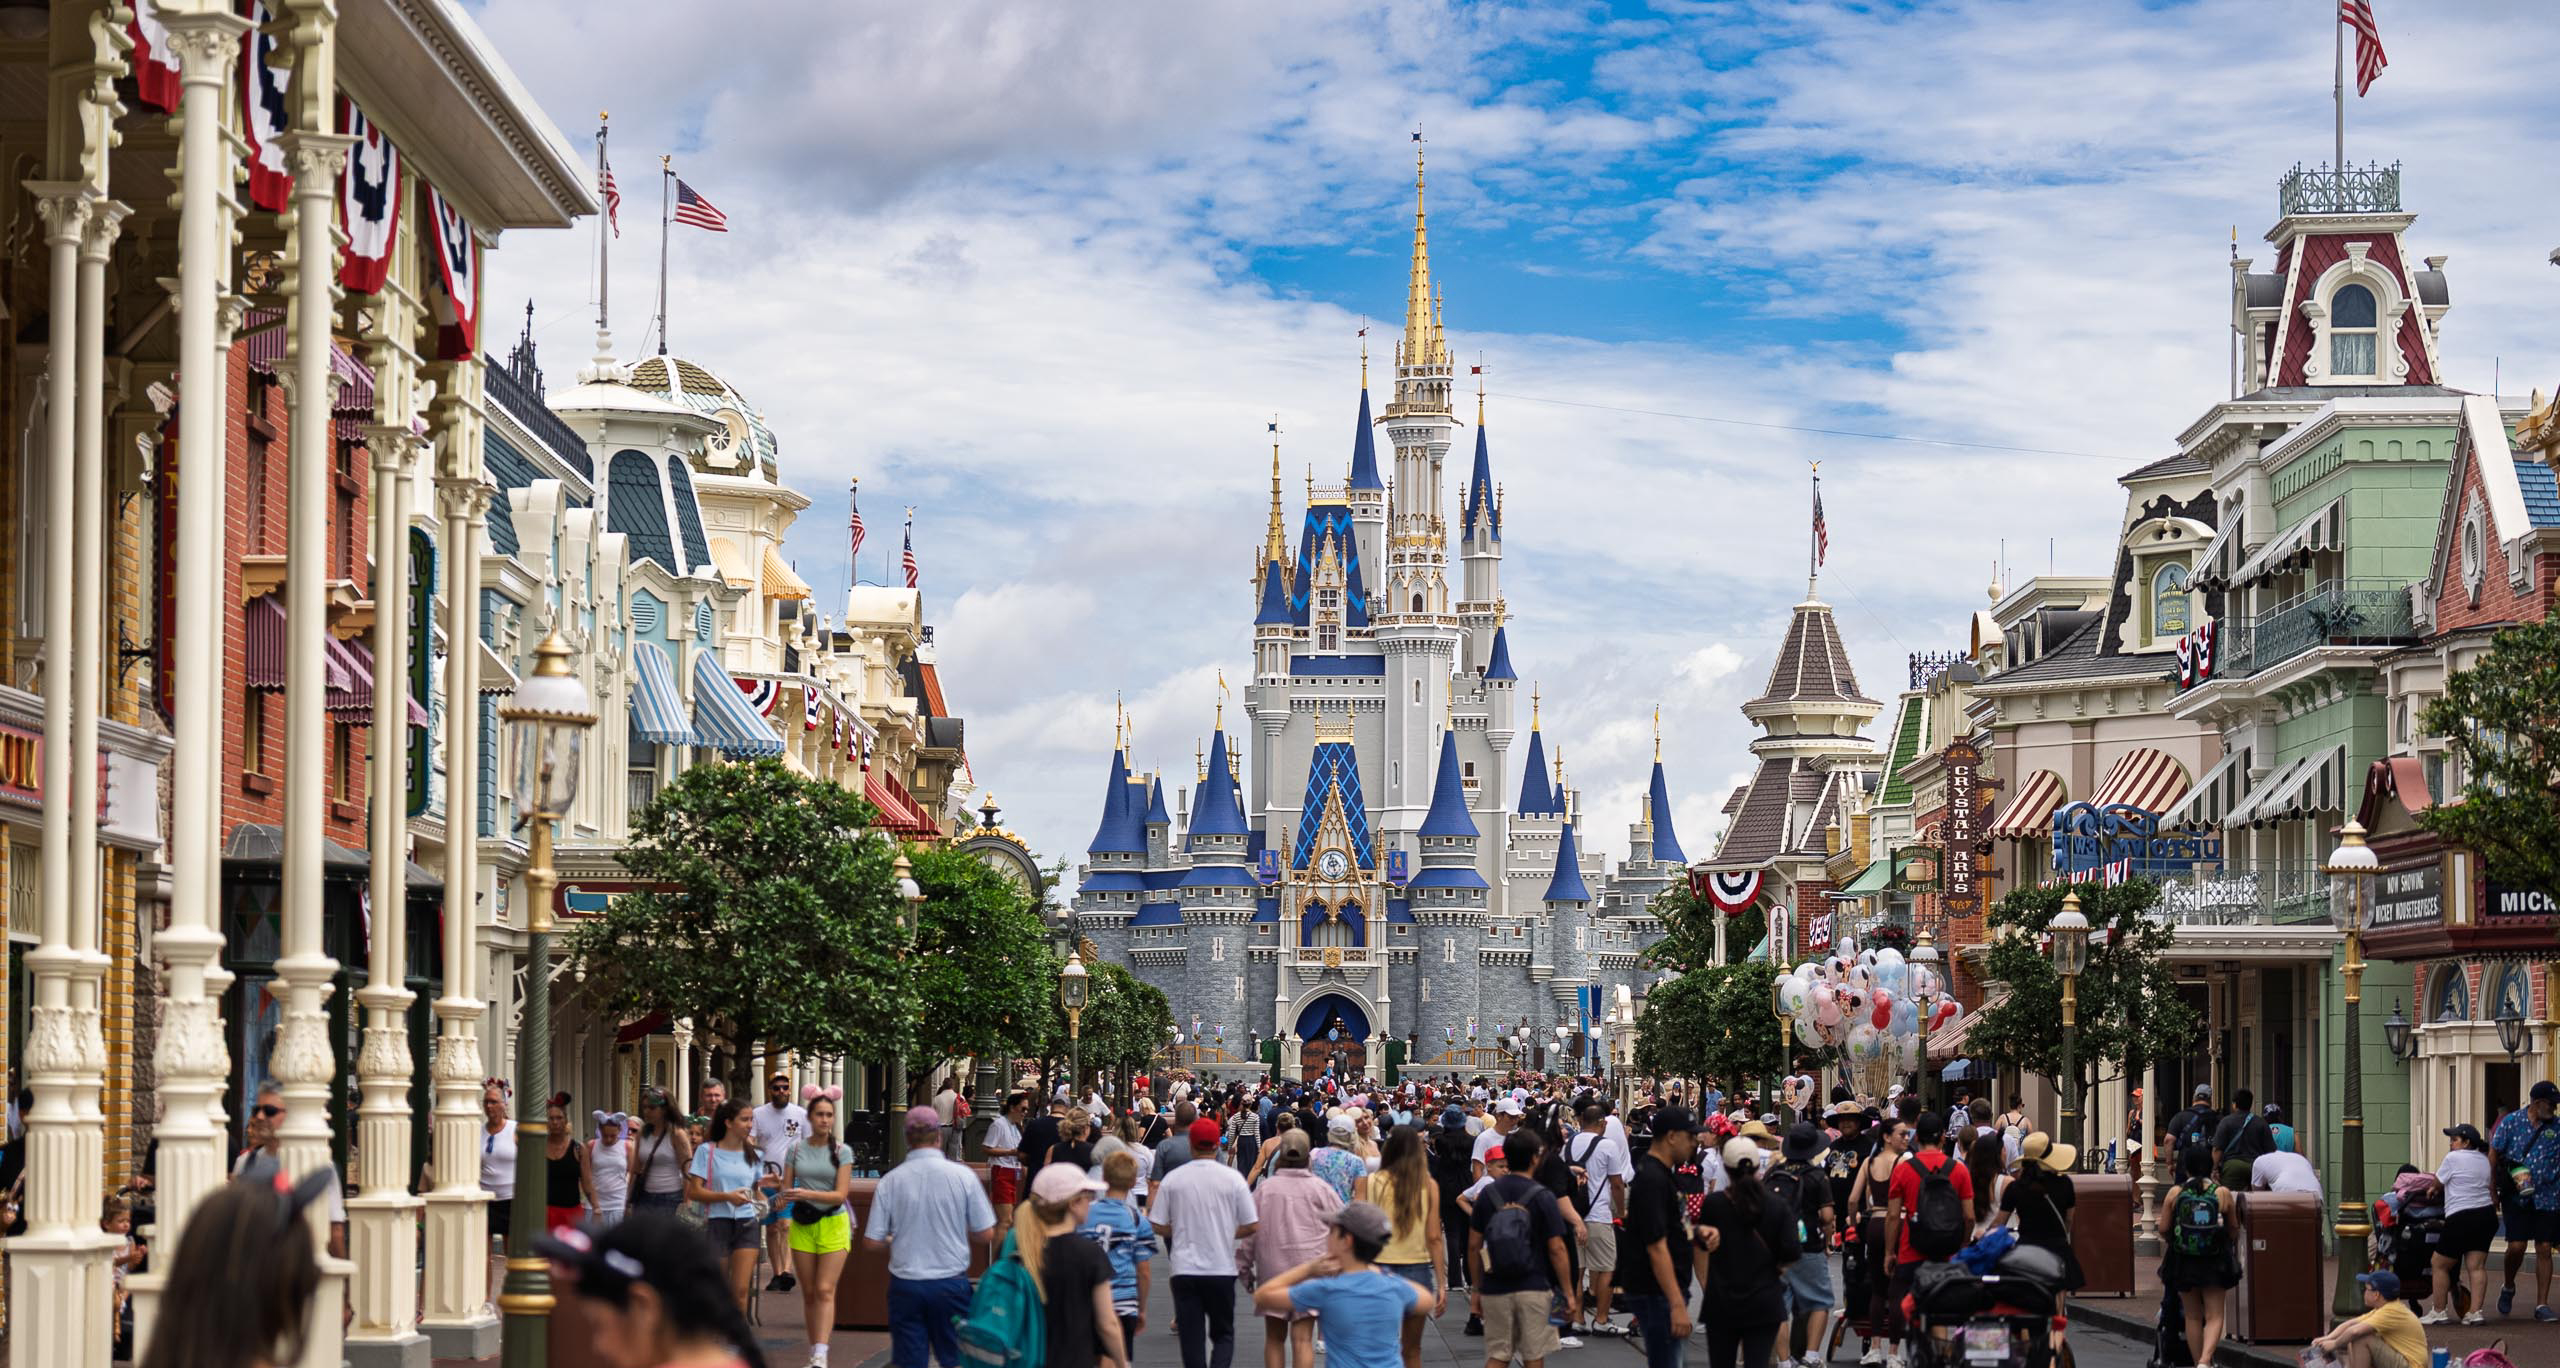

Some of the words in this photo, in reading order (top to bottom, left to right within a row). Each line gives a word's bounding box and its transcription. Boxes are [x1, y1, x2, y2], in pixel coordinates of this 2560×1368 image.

[1953, 765, 1970, 840] CRYSTAL
[1953, 851, 1970, 893] ARTS
[2387, 876, 2398, 894] NOW
[2401, 871, 2424, 892] SHOWING
[1901, 882, 1933, 892] COFFEE
[2375, 904, 2393, 923] MICKEY
